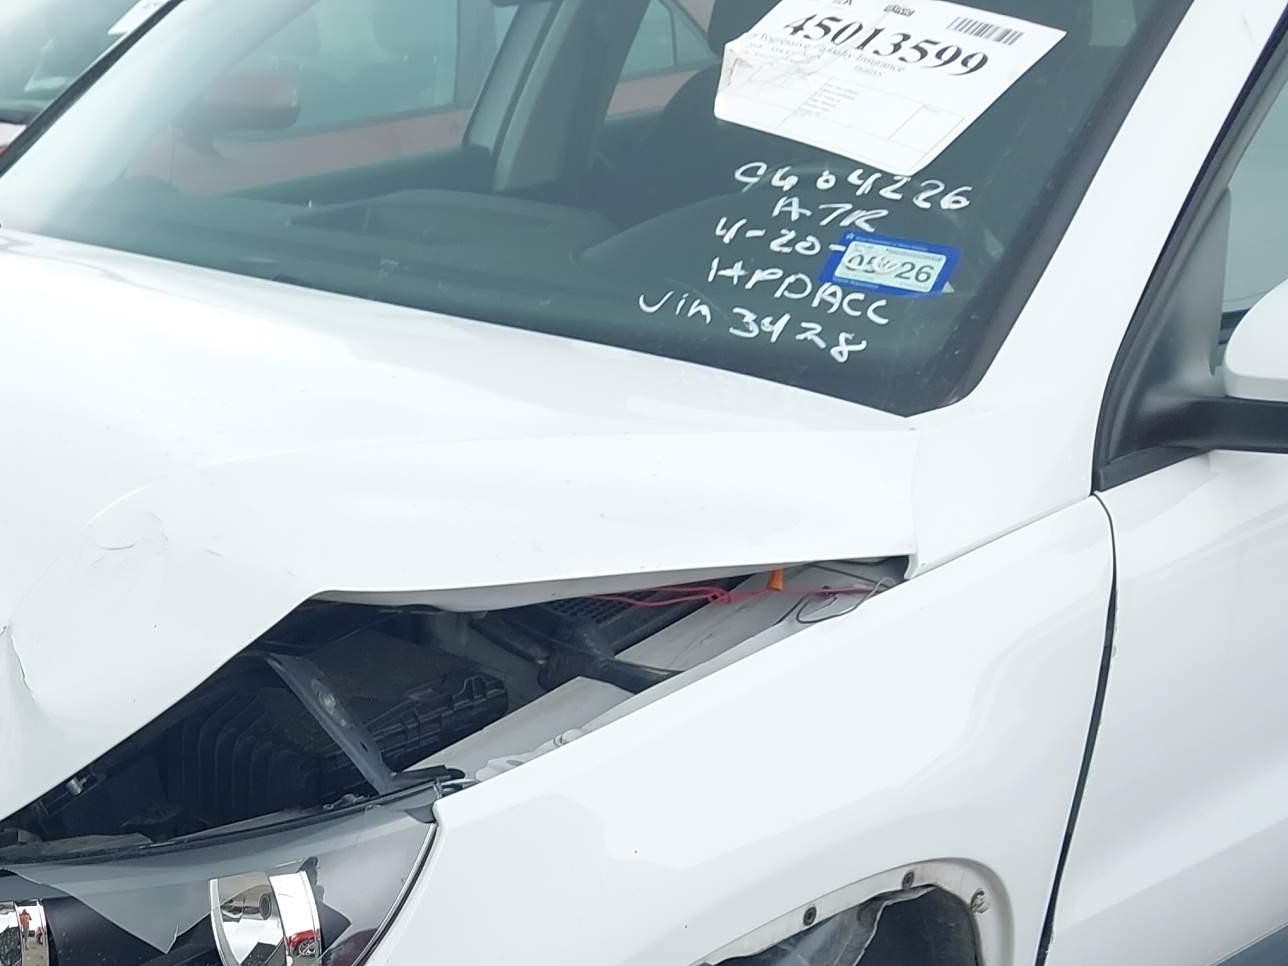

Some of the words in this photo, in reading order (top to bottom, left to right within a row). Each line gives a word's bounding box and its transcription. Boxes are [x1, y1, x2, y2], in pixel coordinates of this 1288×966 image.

[783, 14, 989, 77] 45013599
[894, 261, 935, 283] 26
[728, 306, 868, 363] 3428
